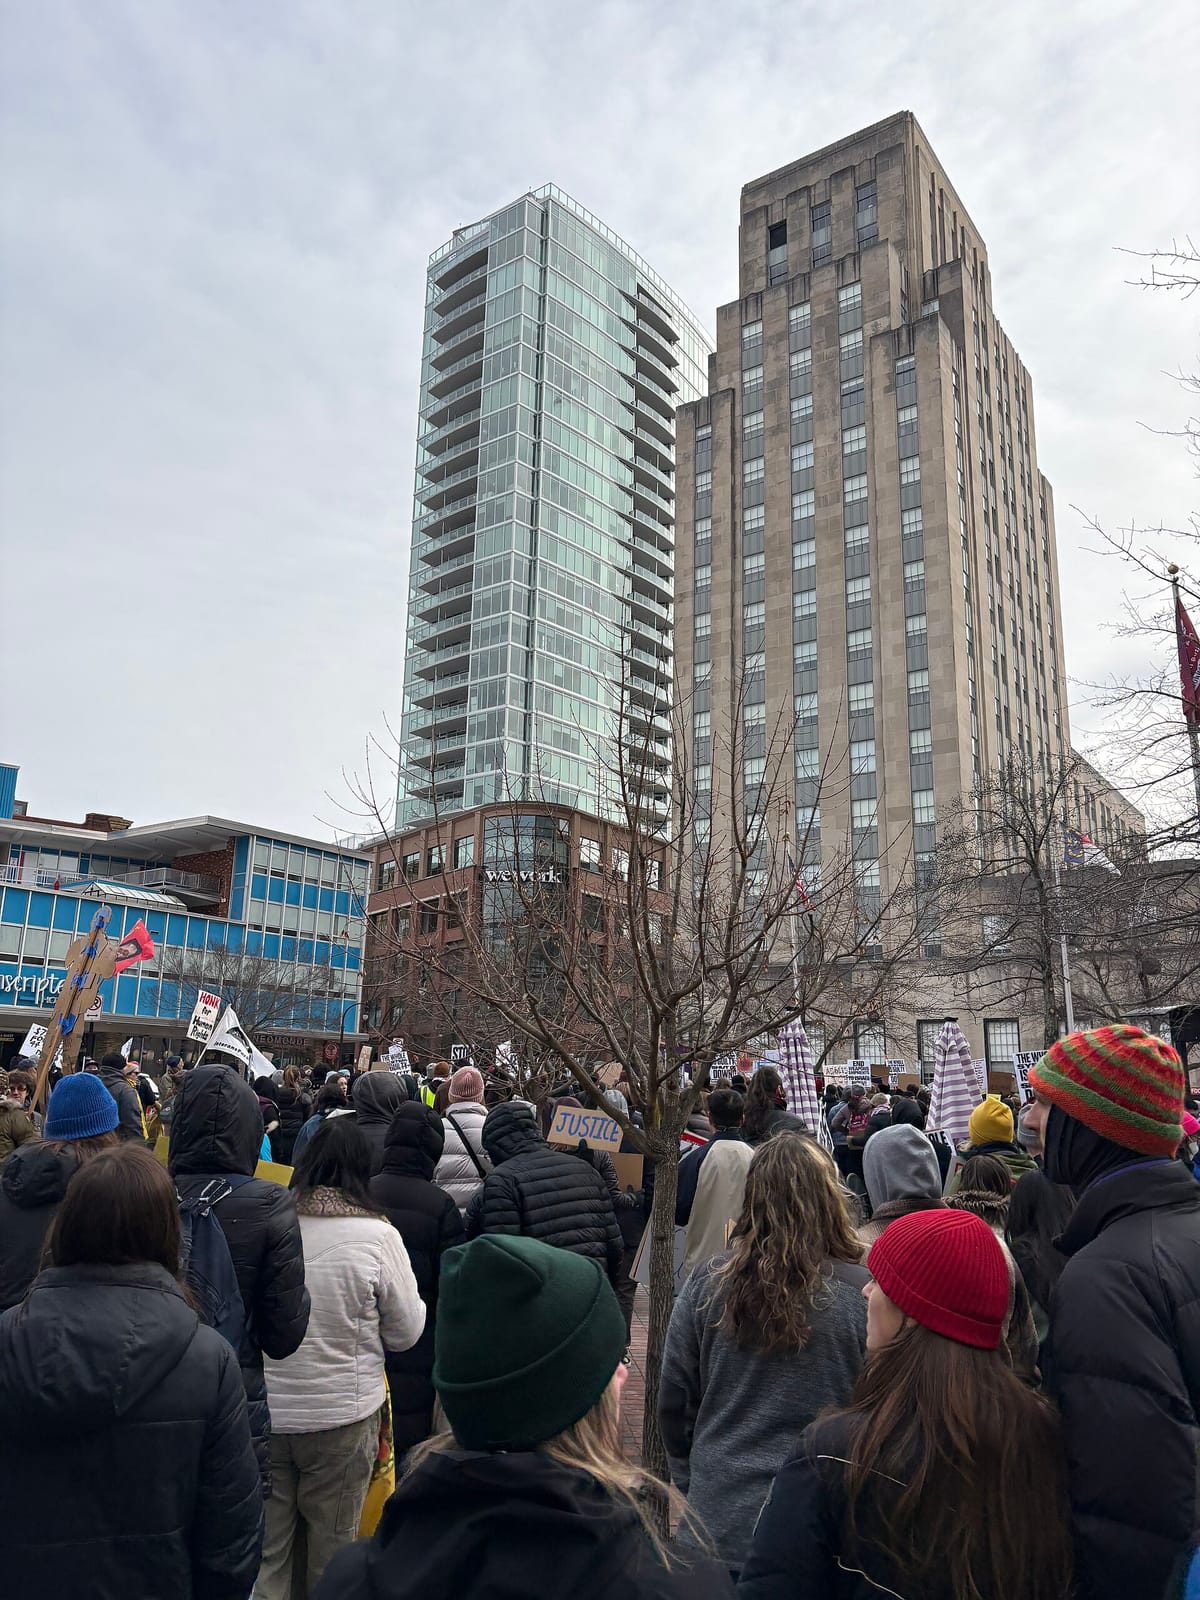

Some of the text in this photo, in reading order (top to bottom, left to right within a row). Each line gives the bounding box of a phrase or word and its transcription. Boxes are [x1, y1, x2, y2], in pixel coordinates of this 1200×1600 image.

[200, 992, 220, 1008] HONK
[252, 1034, 309, 1047] NEOMONDE
[1017, 1053, 1031, 1064] THE
[556, 1112, 619, 1142] JUSTICE
